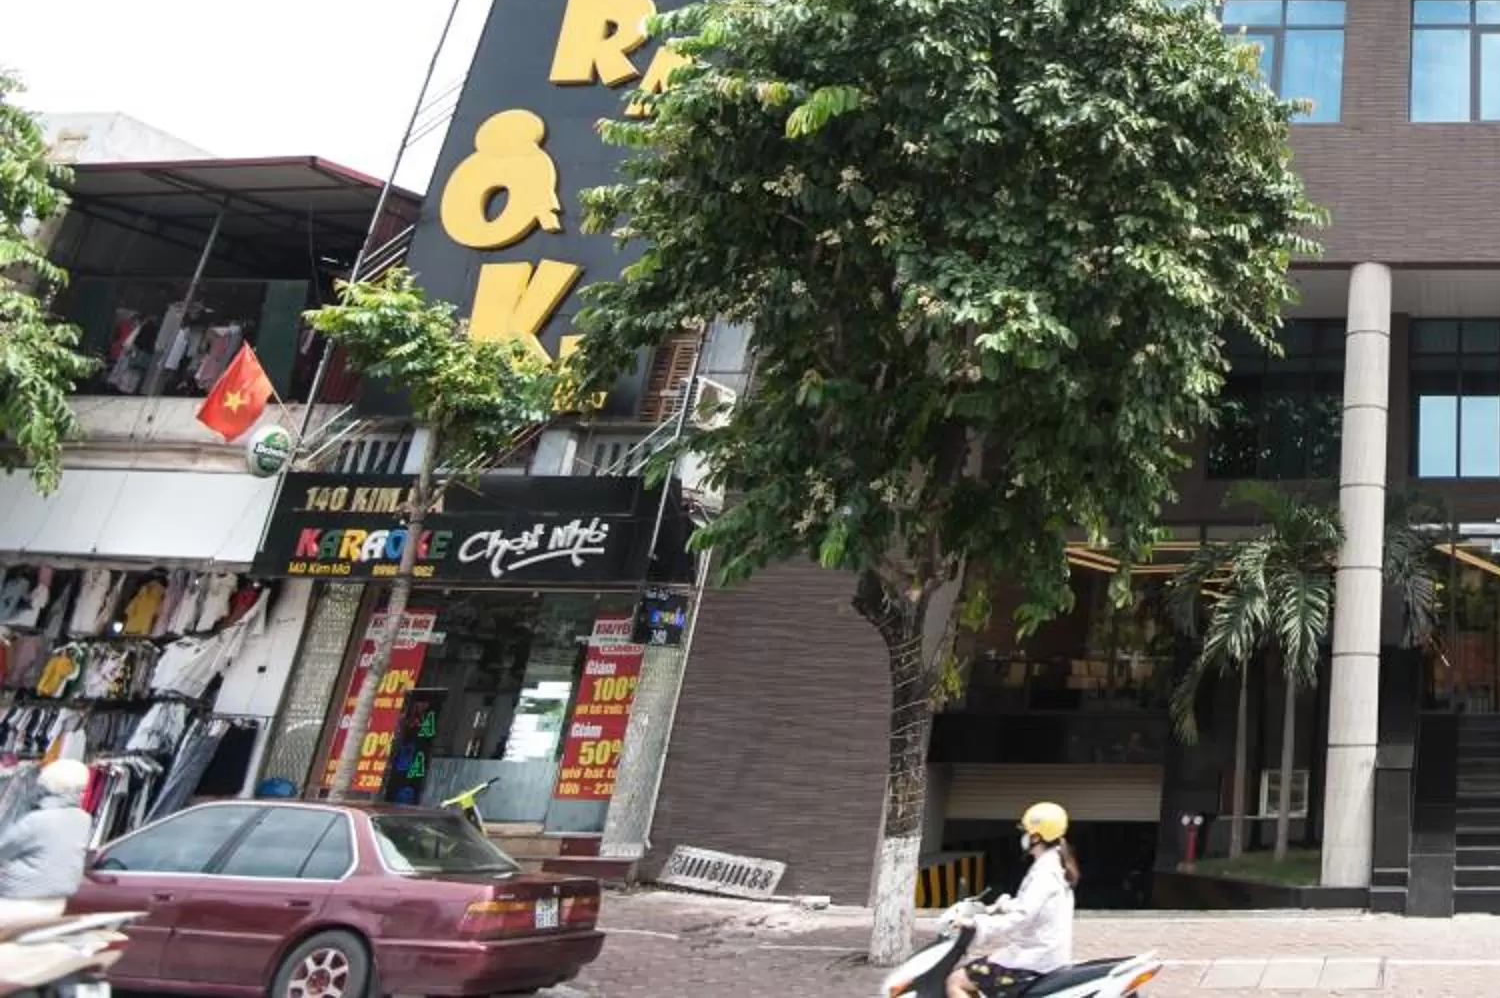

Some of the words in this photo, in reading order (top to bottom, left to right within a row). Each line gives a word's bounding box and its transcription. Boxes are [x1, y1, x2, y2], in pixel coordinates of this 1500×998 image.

[306, 487, 349, 513] 140
[350, 486, 403, 514] KIM
[295, 527, 453, 563] KARAOKE
